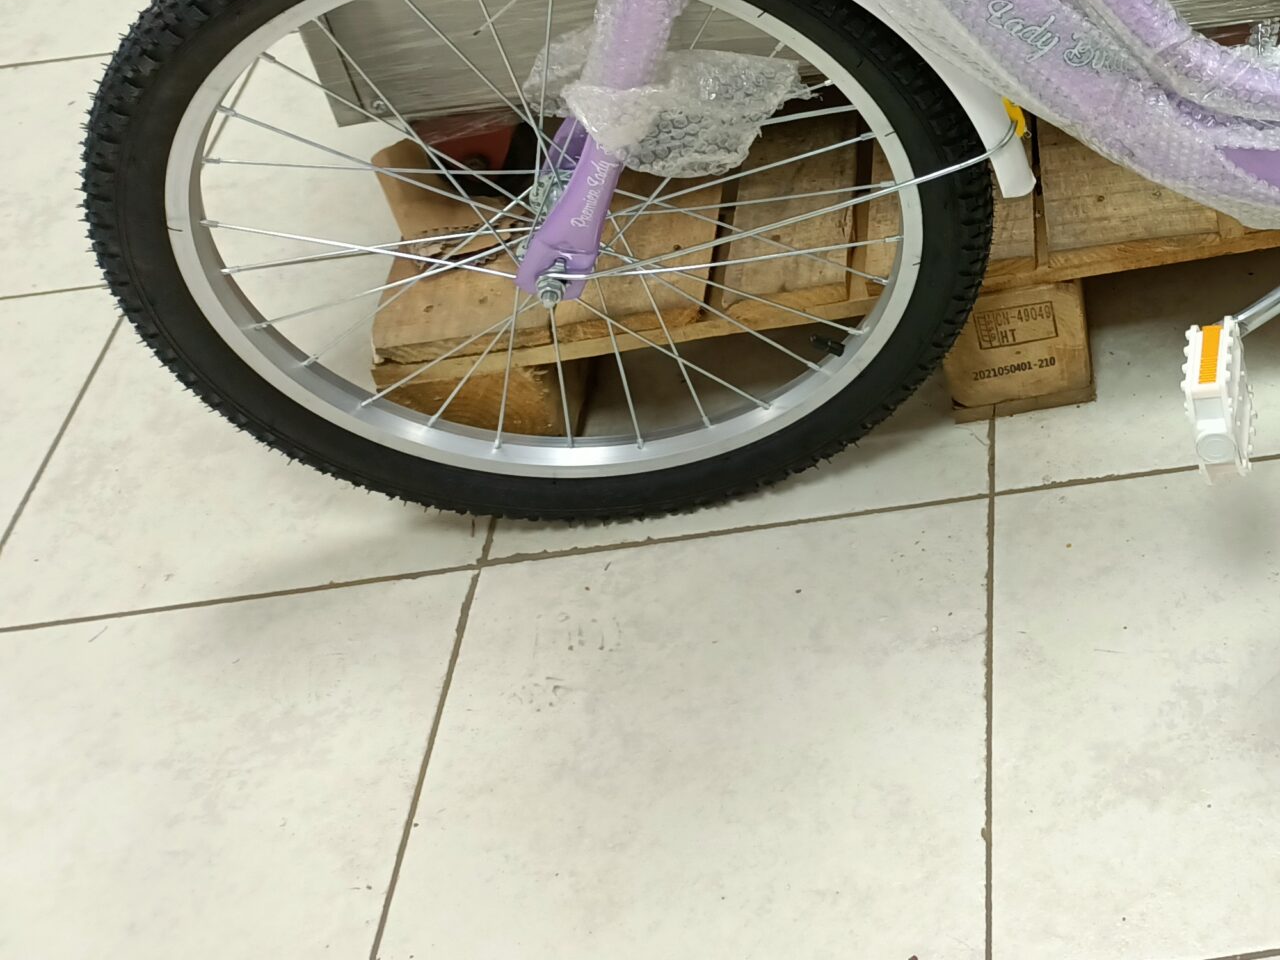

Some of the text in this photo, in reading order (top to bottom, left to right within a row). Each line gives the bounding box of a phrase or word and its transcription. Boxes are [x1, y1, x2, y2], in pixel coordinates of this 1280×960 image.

[570, 159, 620, 229] Premier Lady
[1001, 328, 1017, 344] HT
[973, 356, 1056, 380] 2021050401-210
